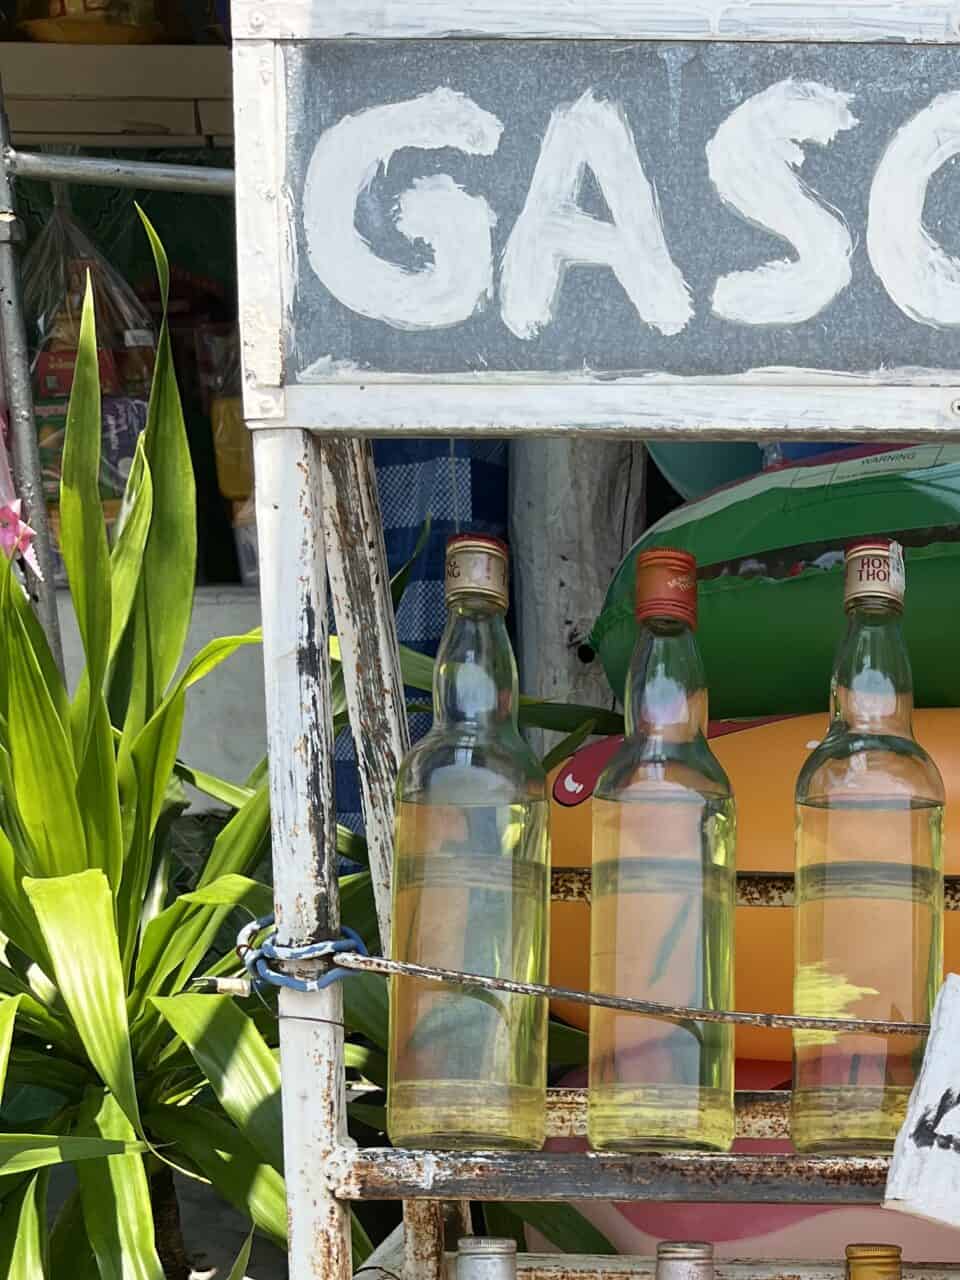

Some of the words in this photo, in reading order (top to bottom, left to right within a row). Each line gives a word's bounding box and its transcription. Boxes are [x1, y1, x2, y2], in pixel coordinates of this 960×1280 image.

[861, 452, 916, 465] WARNING
[861, 558, 890, 569] HON
[856, 569, 890, 582] THO
